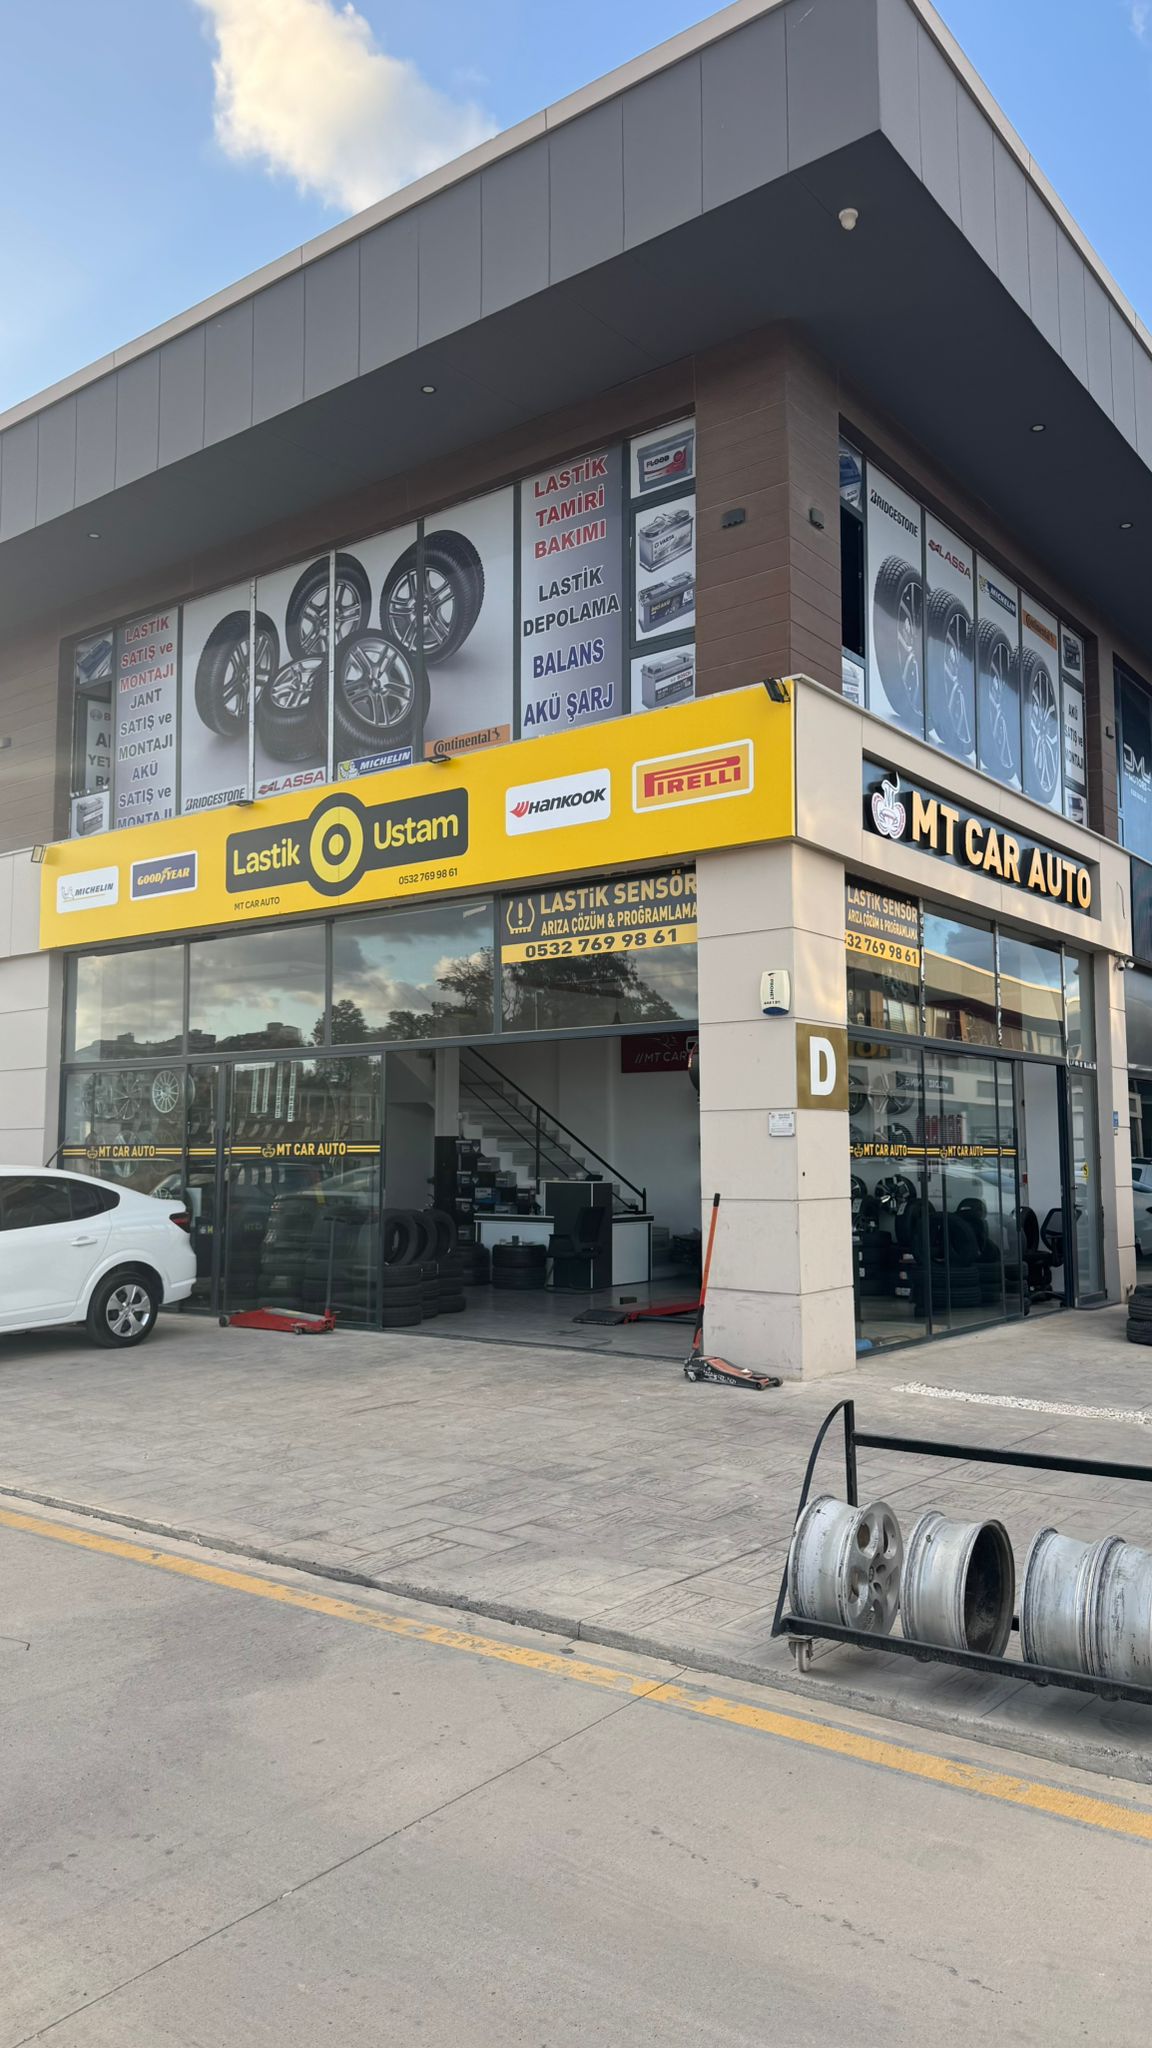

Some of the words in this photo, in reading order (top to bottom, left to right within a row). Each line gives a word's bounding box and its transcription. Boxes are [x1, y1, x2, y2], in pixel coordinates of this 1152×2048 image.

[534, 455, 608, 498] LASTİK
[536, 484, 604, 528] TAMİRİ
[870, 489, 919, 537] BRIDGESTONE
[534, 519, 606, 560] BAKIMI
[938, 545, 971, 580] LASSA
[538, 565, 603, 602] LASTİK
[523, 594, 620, 637] DEPOLAMA
[126, 616, 170, 643] LASTİK
[121, 645, 155, 668] SATIŞ
[160, 642, 173, 655] ve
[533, 638, 604, 679] BALANS
[120, 663, 174, 693] MONTAJI
[130, 688, 162, 710] JANT
[524, 692, 560, 727] AKÜ
[566, 683, 614, 722] ŞARJ
[120, 715, 154, 736] SATIŞ
[158, 713, 172, 725] ve
[119, 734, 173, 761] MONTAJI
[433, 730, 492, 756] Continental
[132, 760, 158, 782] AKÜ
[360, 752, 411, 770] MICHELIN
[274, 770, 324, 792] LASSA
[644, 756, 740, 798] PIRELLI
[120, 787, 154, 808] SATIŞ
[157, 786, 172, 798] ve
[184, 788, 246, 811] BRIDGESTONE
[232, 838, 300, 876] Lastik
[374, 814, 458, 850] Ustam
[912, 791, 960, 855] MT
[965, 818, 1020, 882] CAR
[1028, 848, 1092, 909] AUTO
[74, 882, 114, 896] MICHELIN
[398, 874, 419, 886] 0532
[420, 871, 434, 883] 769
[436, 869, 447, 880] 98
[448, 868, 458, 878] 61
[614, 870, 697, 905] SENSÖR
[234, 900, 244, 910] MT
[245, 898, 260, 909] CAR
[260, 896, 280, 908] AUTO
[882, 898, 918, 923] SENSÖR
[541, 917, 570, 937] ARIZA
[571, 912, 604, 934] ÇÖZÜM
[607, 915, 615, 928] &
[525, 941, 572, 958] 0532
[578, 935, 615, 952] 769
[622, 932, 646, 948] 98
[653, 928, 677, 944] 61
[846, 932, 862, 949] 32
[864, 938, 886, 956] 769
[888, 944, 902, 960] 98
[905, 949, 916, 964] 61
[810, 1036, 836, 1096] D
[99, 1146, 111, 1157] MT
[112, 1146, 130, 1156] CAR
[131, 1146, 155, 1156] AUTO
[276, 1144, 291, 1156] MT
[294, 1143, 315, 1156] CAR
[318, 1142, 346, 1155] AUTO
[864, 1144, 874, 1156] MT
[874, 1144, 889, 1156] CAR
[890, 1145, 907, 1156] AUTO
[947, 1146, 956, 1156] MT
[956, 1146, 969, 1156] CAR
[970, 1146, 984, 1156] AUTO
